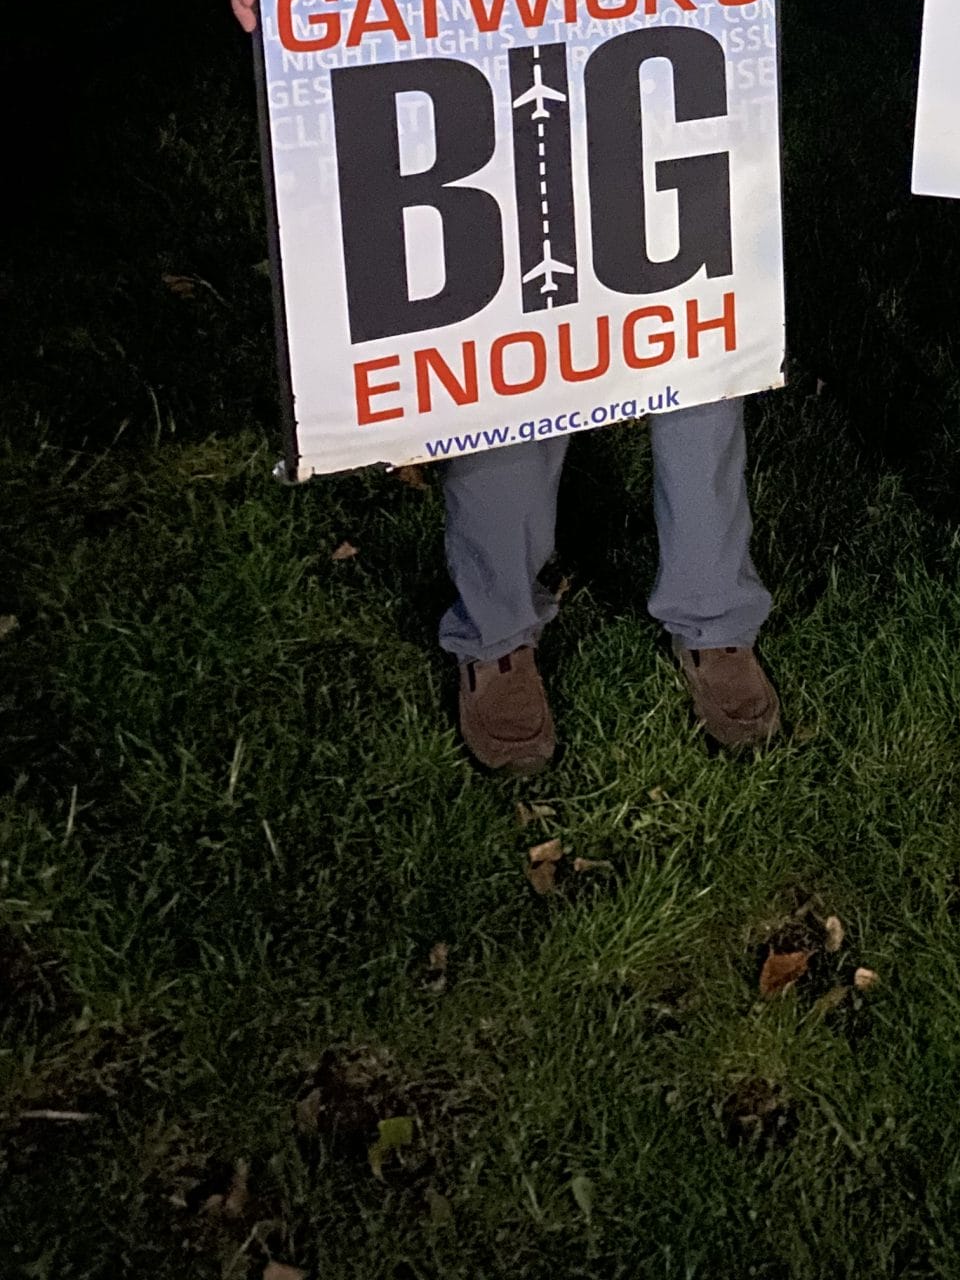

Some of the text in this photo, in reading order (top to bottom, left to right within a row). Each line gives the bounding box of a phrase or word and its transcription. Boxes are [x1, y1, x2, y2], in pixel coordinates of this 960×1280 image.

[330, 26, 733, 345] BIG
[353, 292, 736, 426] ENOUGH
[425, 386, 680, 457] www.gacc.org.uk
